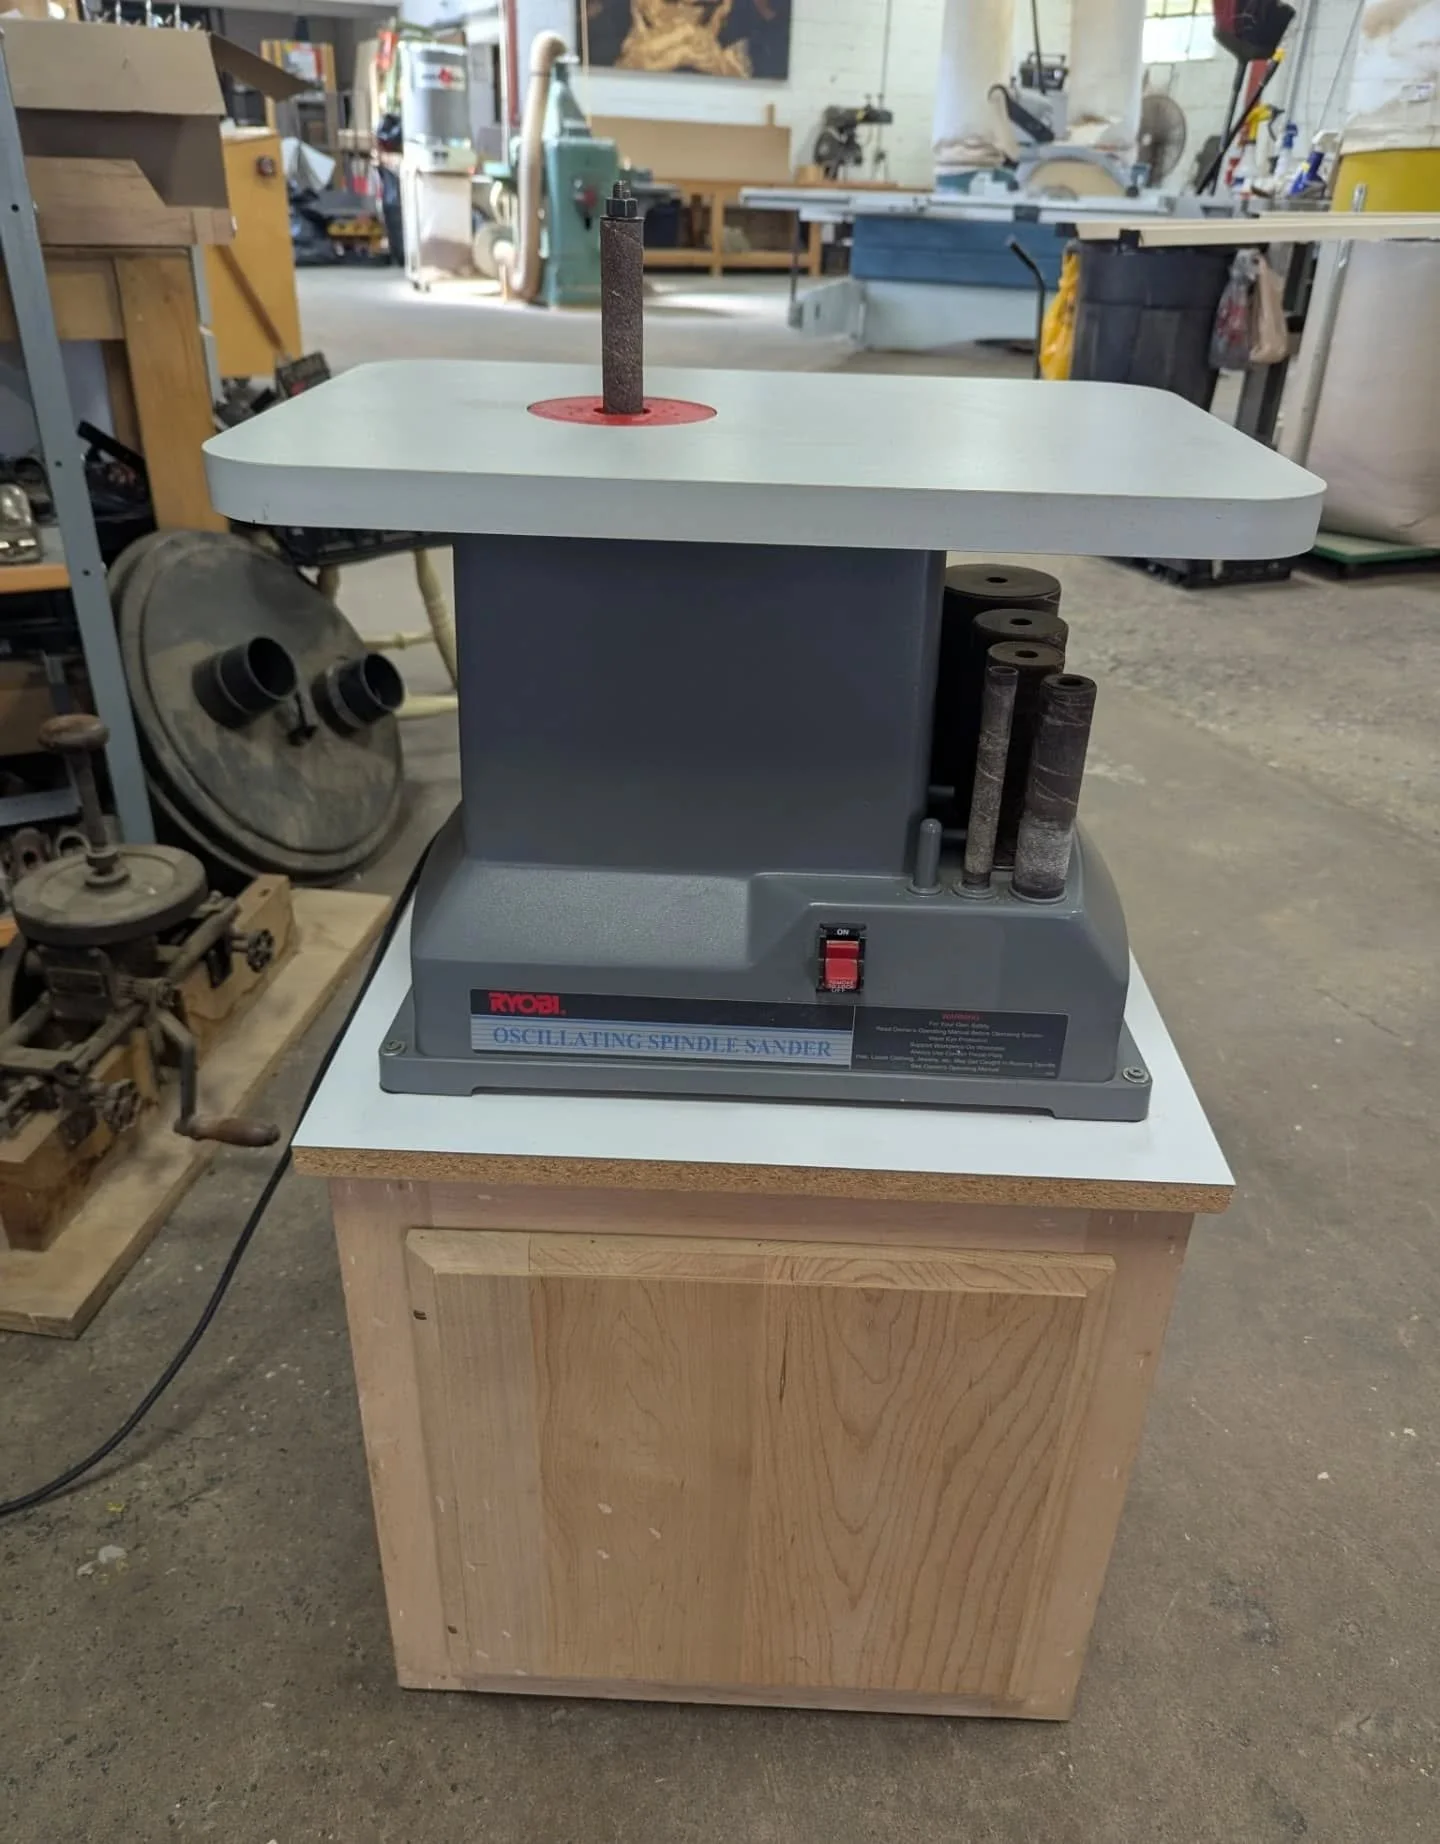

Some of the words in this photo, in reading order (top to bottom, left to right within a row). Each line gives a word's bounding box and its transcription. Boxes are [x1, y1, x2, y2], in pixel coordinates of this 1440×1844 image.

[836, 928, 850, 936] ON
[488, 992, 560, 1015] RYOBI
[493, 1026, 641, 1050] OSCILLATING
[647, 1034, 739, 1053] SPINDLE
[745, 1038, 832, 1057] SANDER
